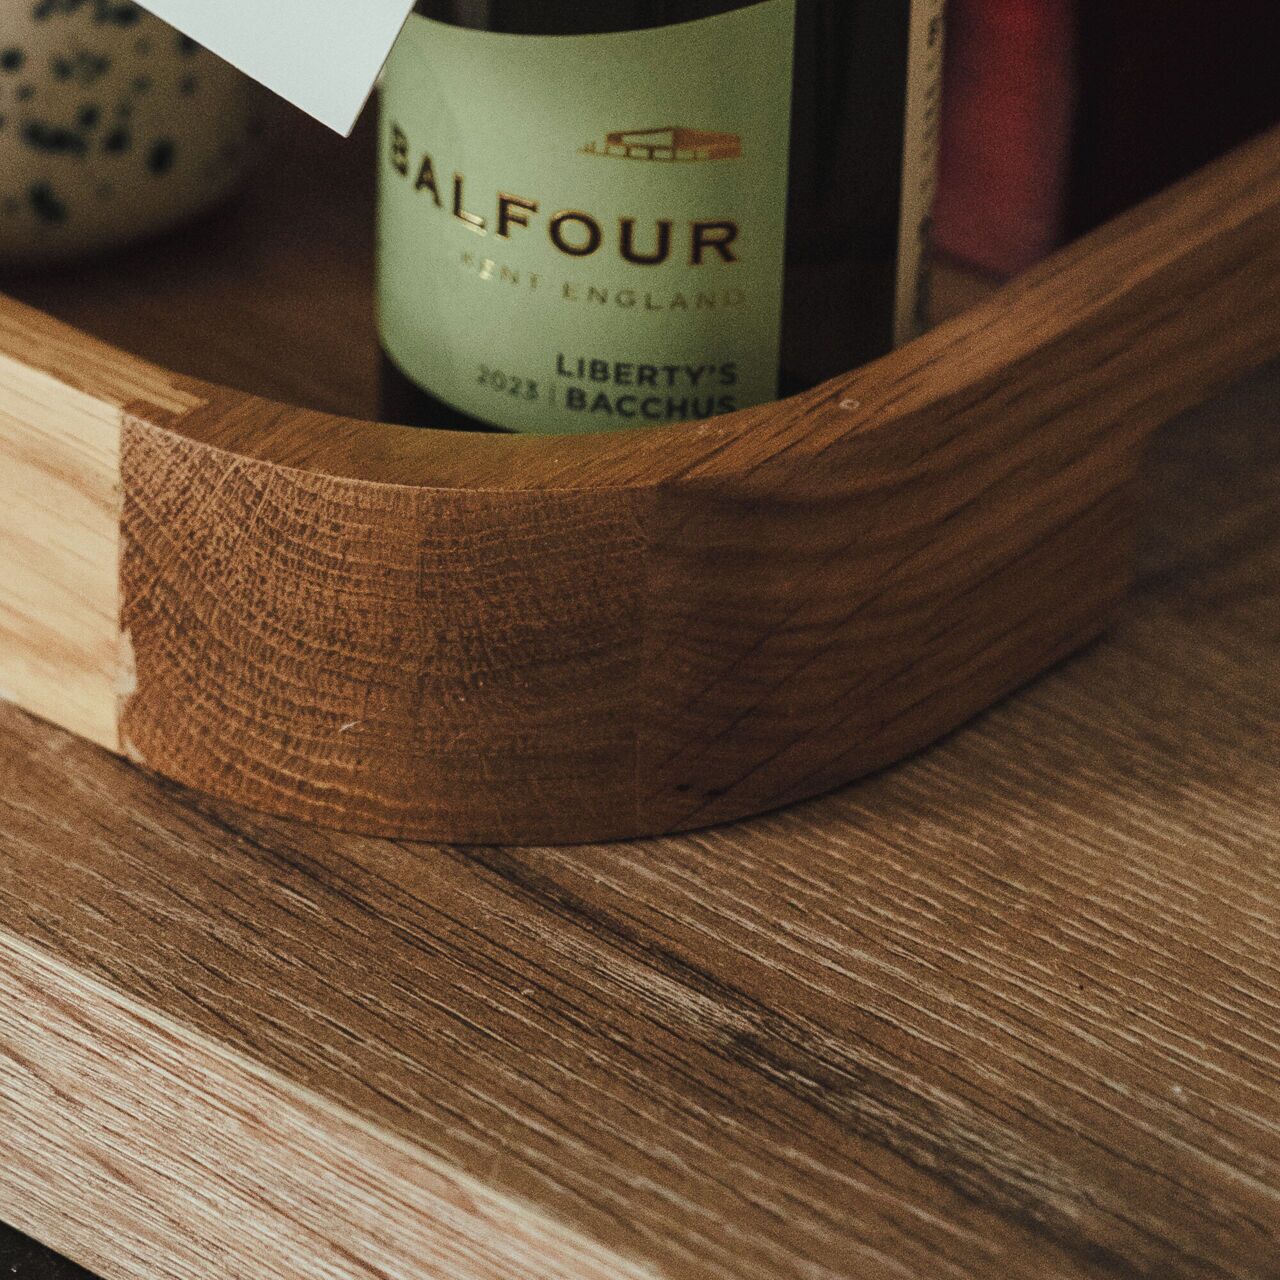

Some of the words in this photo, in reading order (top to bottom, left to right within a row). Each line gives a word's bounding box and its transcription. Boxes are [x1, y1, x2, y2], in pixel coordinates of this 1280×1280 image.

[391, 121, 740, 267] BALFOUR
[459, 251, 545, 291] KENT
[560, 281, 748, 313] ENGLAND
[476, 363, 540, 400] 2023
[566, 386, 738, 423] BACCHUS
[555, 352, 738, 388] LIBERTY'S
